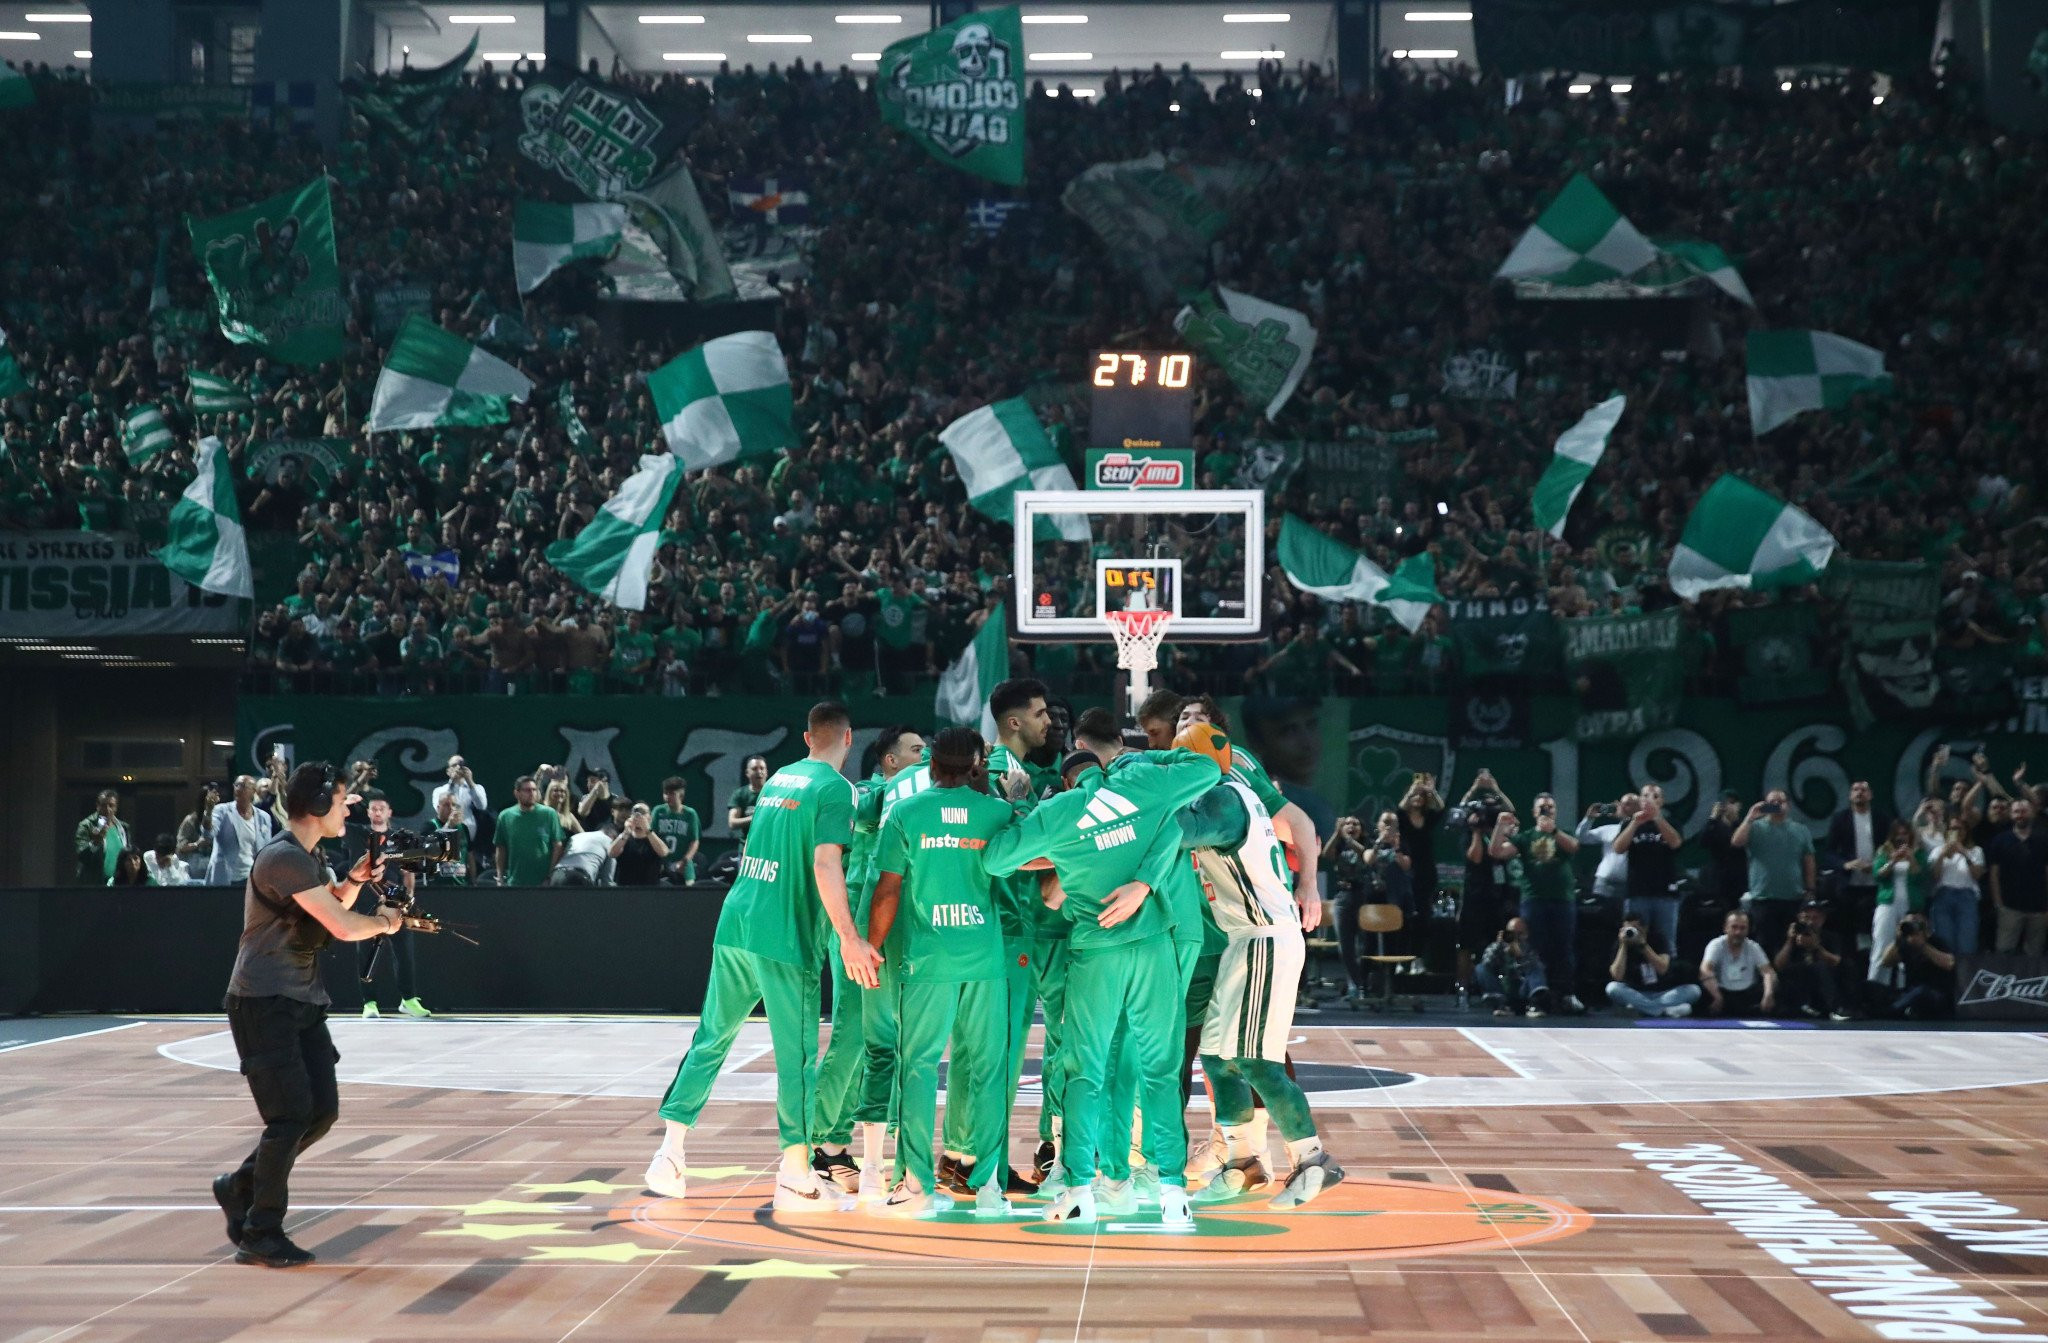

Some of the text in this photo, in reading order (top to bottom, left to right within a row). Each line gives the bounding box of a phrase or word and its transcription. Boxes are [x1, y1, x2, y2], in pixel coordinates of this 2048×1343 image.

[26, 541, 114, 560] STRIKES
[941, 807, 968, 824] NUNN
[921, 833, 987, 850] instacar
[1094, 825, 1137, 850] BROWN
[932, 904, 985, 926] ATHENS
[1979, 974, 2048, 999] Bud
[1646, 1163, 2048, 1341] PANATHINAIKOS
